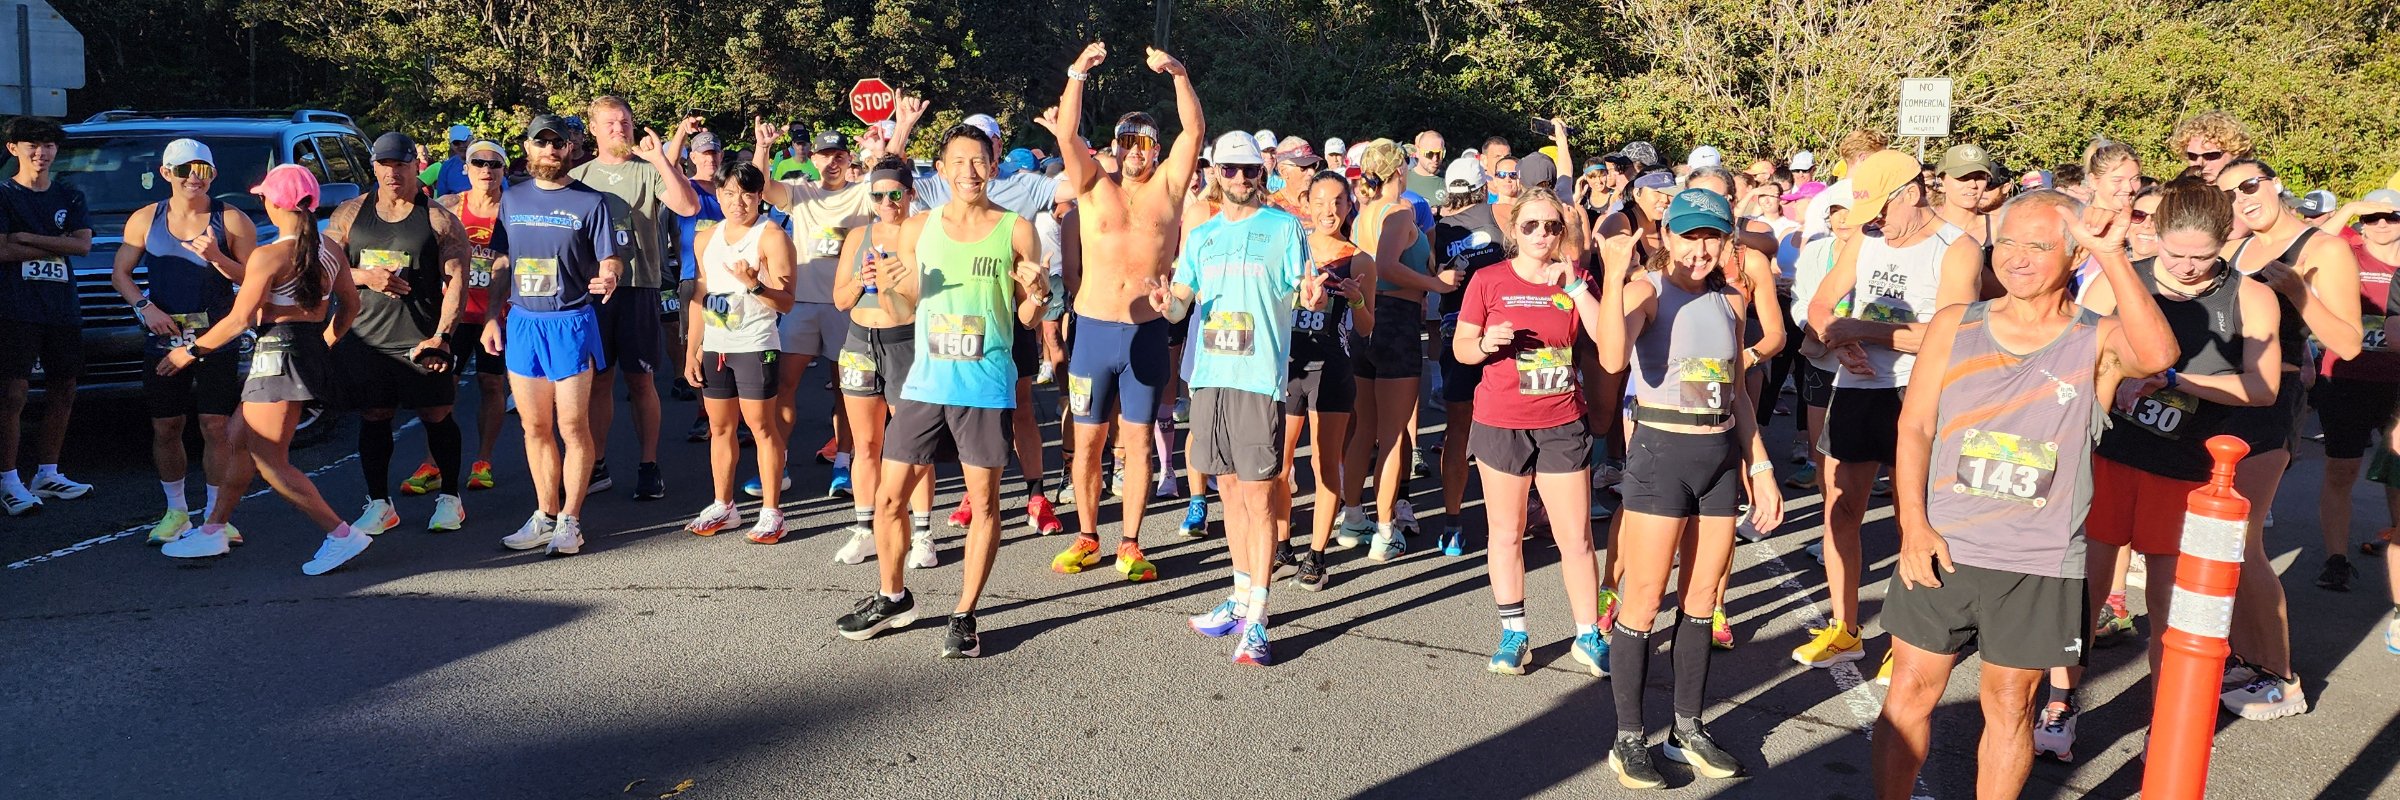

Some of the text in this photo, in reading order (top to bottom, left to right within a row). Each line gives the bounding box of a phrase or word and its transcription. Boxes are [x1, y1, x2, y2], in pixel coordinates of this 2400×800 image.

[1919, 83, 1934, 91] NO
[853, 92, 892, 112] STOP
[1904, 99, 1947, 108] COMMERCIAL
[1908, 115, 1941, 123] ACTIVITY
[817, 239, 840, 255] 42
[28, 261, 64, 278] 345
[971, 256, 1002, 278] KRC
[469, 270, 490, 287] 39
[520, 274, 545, 292] 57
[1872, 270, 1908, 285] PACE
[1868, 285, 1905, 300] TEAM
[934, 333, 978, 357] 150
[1214, 330, 1240, 350] 44
[842, 368, 864, 387] 38
[1526, 366, 1569, 390] 172
[1707, 382, 1722, 409] 3
[1969, 458, 2039, 498] 143
